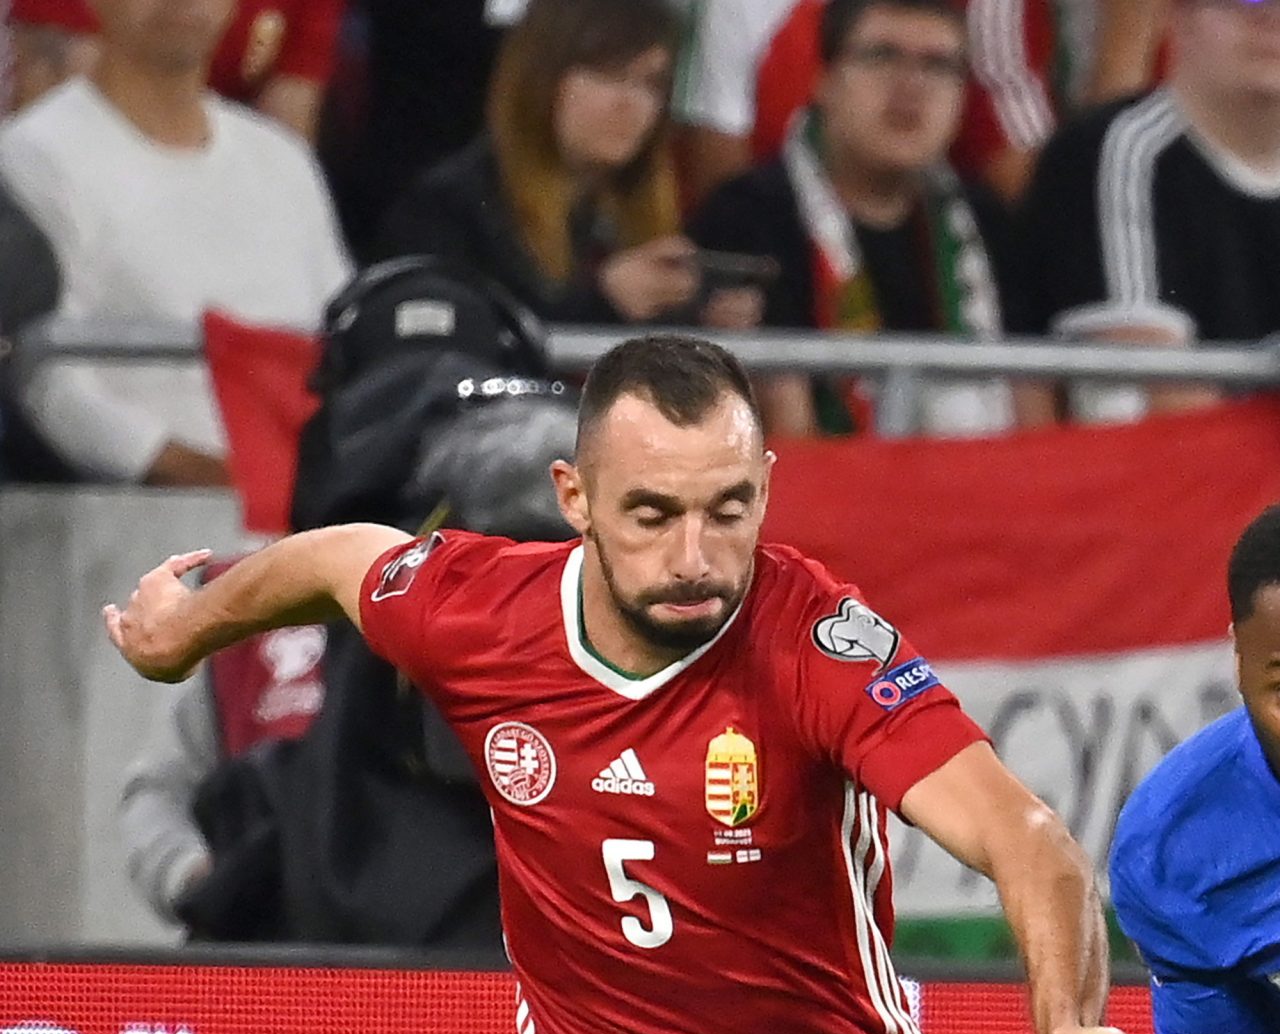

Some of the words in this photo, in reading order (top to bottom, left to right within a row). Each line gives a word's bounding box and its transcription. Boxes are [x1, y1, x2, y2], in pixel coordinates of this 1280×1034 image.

[895, 664, 932, 691] RESP
[591, 776, 656, 797] adidas
[602, 838, 673, 949] 5
